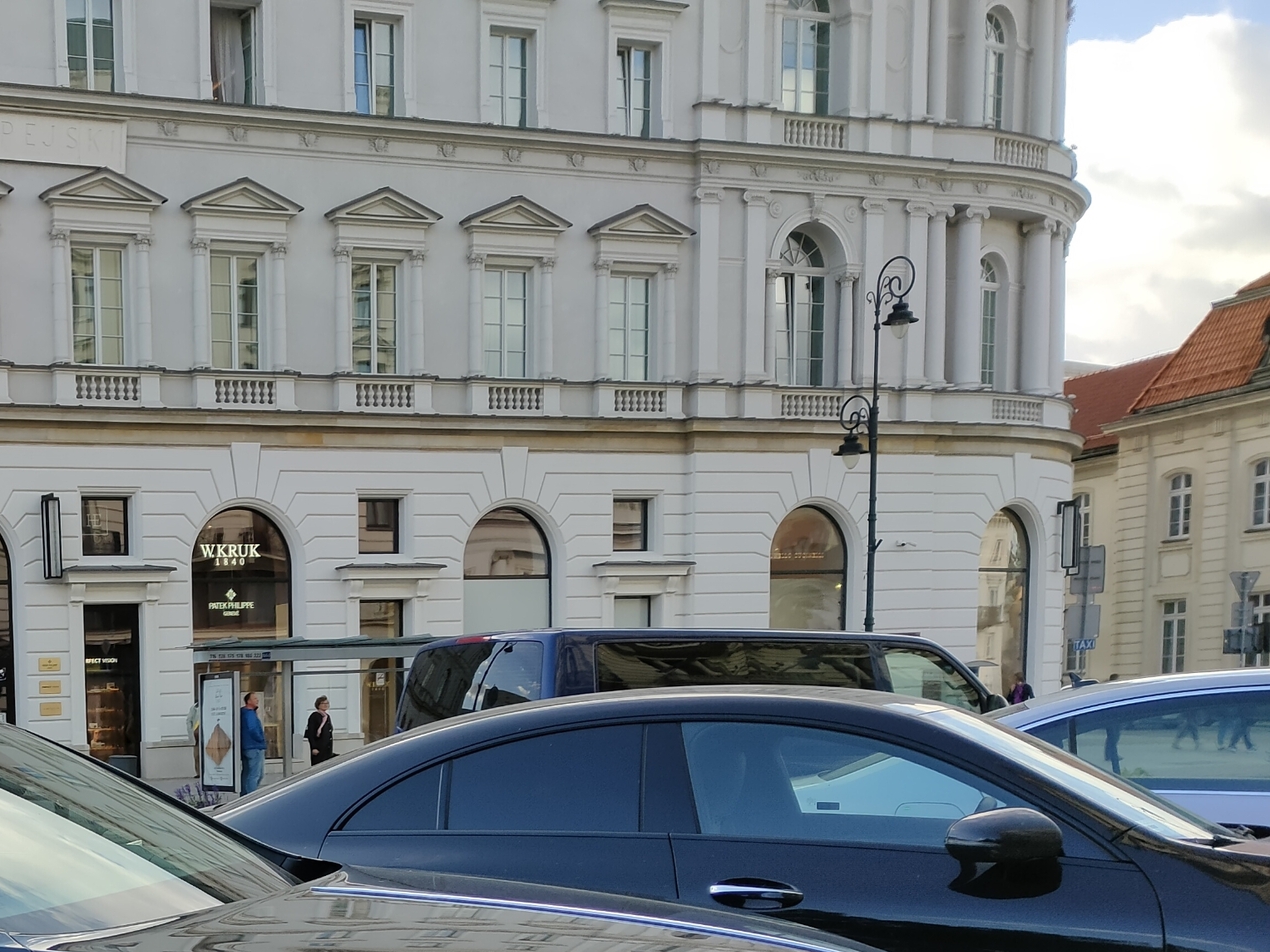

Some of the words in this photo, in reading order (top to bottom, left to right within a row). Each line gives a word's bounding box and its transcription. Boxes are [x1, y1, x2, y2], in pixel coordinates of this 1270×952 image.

[199, 543, 262, 558] W.KRUK
[215, 558, 246, 566] 1840
[208, 602, 227, 610] PATEK
[228, 601, 255, 609] PHILIPPE
[1074, 640, 1096, 650] TAXI
